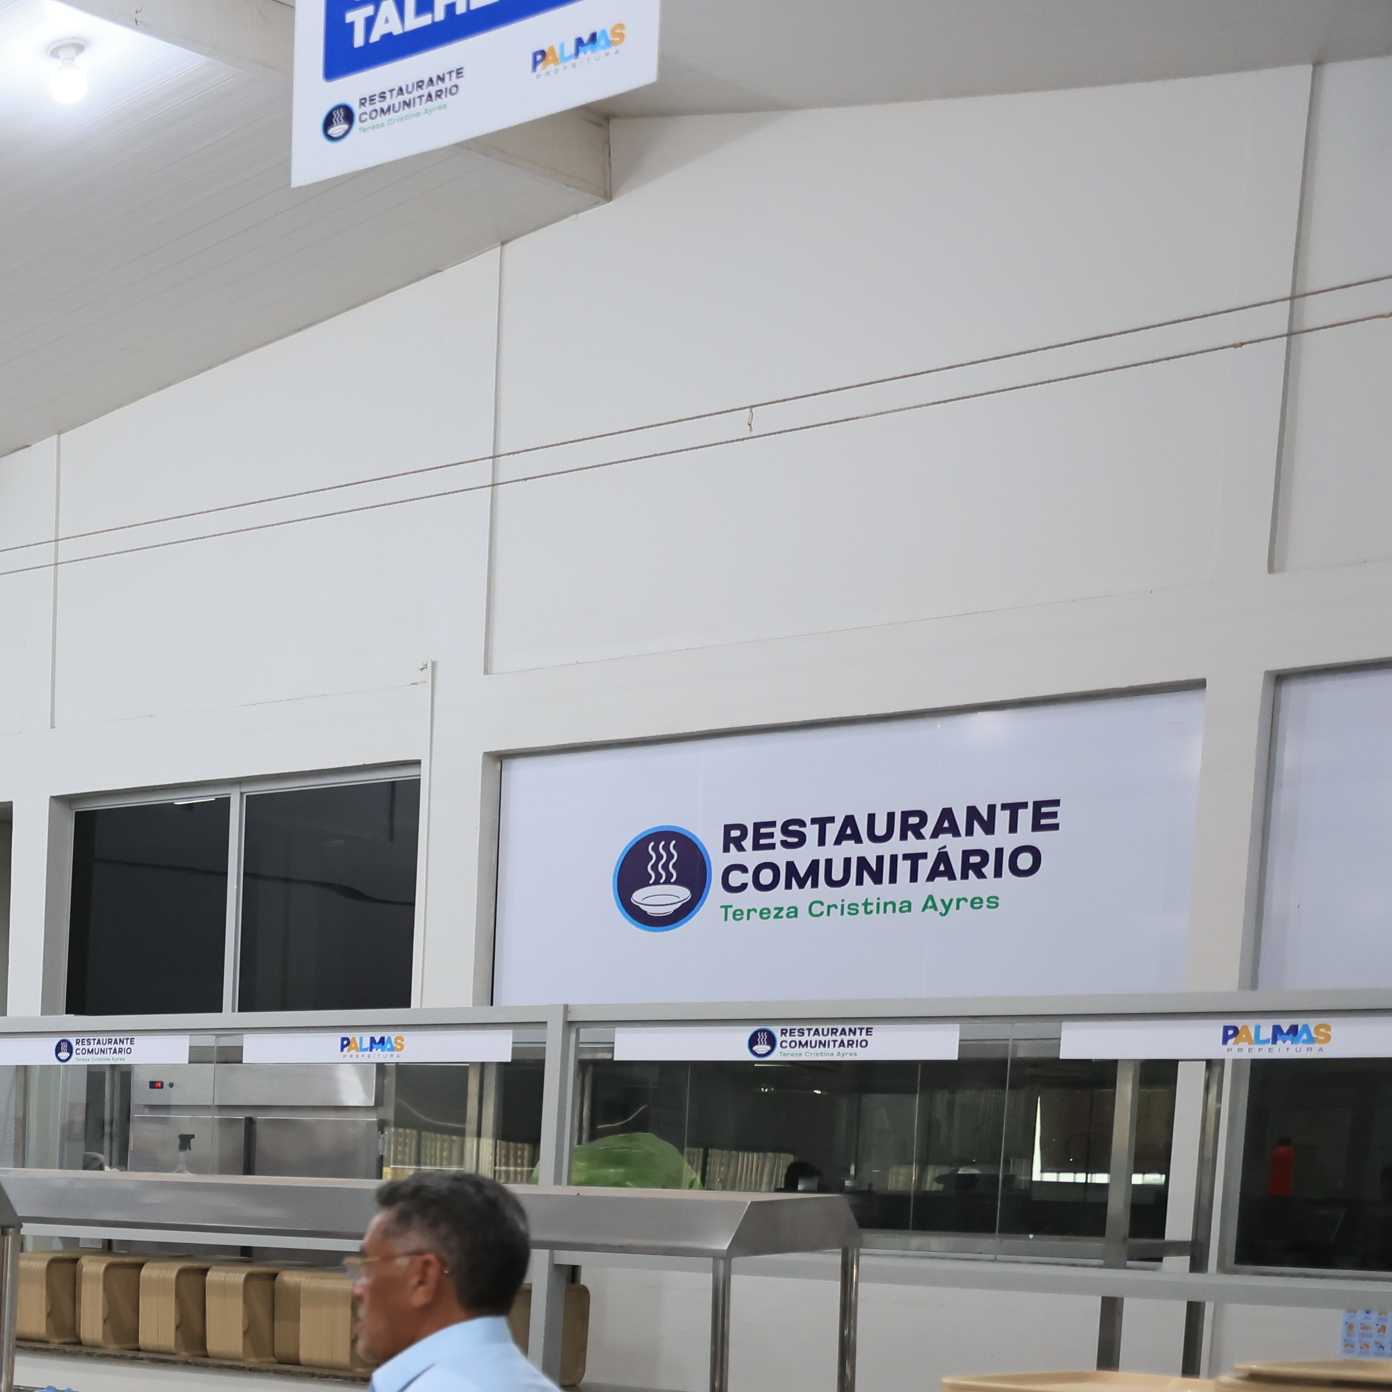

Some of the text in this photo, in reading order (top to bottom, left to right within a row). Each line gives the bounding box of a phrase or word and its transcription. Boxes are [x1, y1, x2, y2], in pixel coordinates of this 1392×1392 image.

[531, 23, 626, 73] PALMAS
[358, 67, 465, 109] RESTAURANTE
[358, 84, 460, 124] COMUNITÁRIO
[358, 103, 447, 134] Tereza Cristina Ayres
[722, 799, 1061, 853] RESTAURANTE
[721, 844, 1042, 893] COMUNITÁRIO
[720, 894, 1000, 922] Tereza Cristina Ayres
[76, 1037, 135, 1046] RESTAURANTE
[340, 1036, 405, 1052] PALMAS
[779, 1038, 869, 1049] COMUNITÁRIO
[780, 1027, 874, 1037] RESTAURANTE
[1222, 1023, 1332, 1045] PALMAS
[75, 1047, 132, 1055] COMUNITÁRIO
